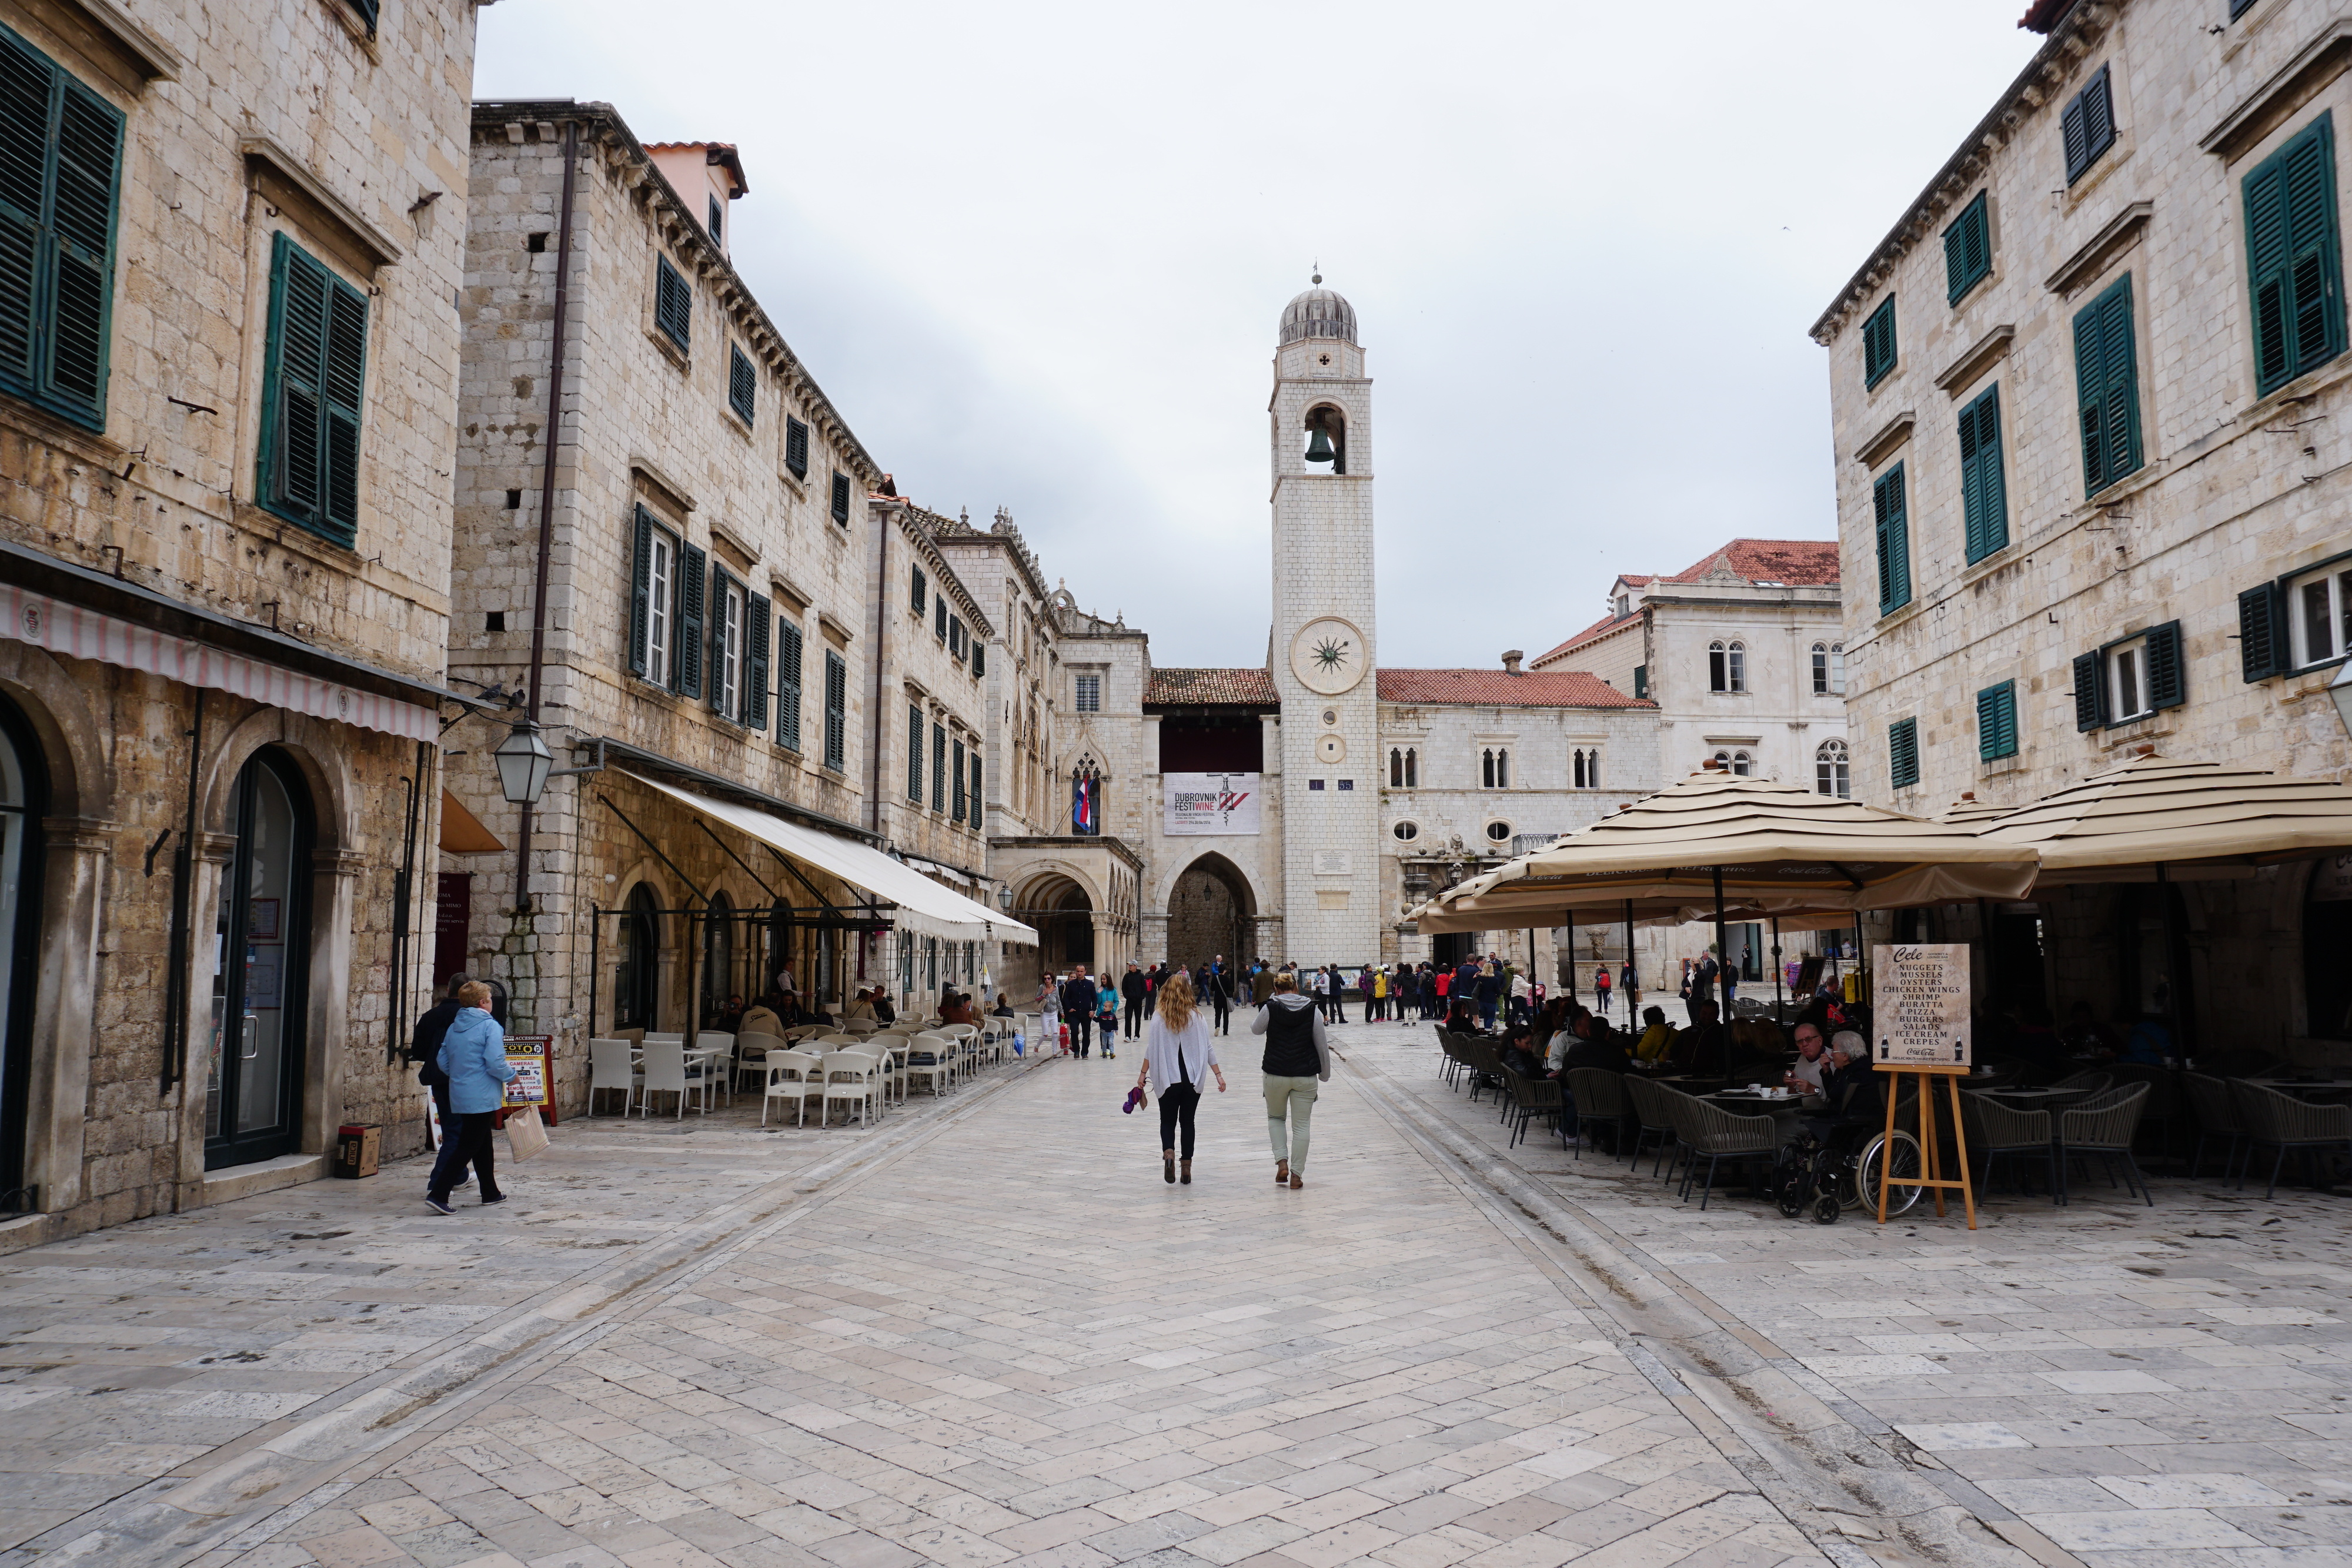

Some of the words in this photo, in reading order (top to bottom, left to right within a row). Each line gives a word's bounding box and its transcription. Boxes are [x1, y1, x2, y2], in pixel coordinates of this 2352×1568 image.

[1339, 781, 1352, 790] 55
[1175, 793, 1217, 802] DUBROVNIK
[1175, 802, 1214, 811] FESTIWINE
[1893, 947, 1922, 962] Cele
